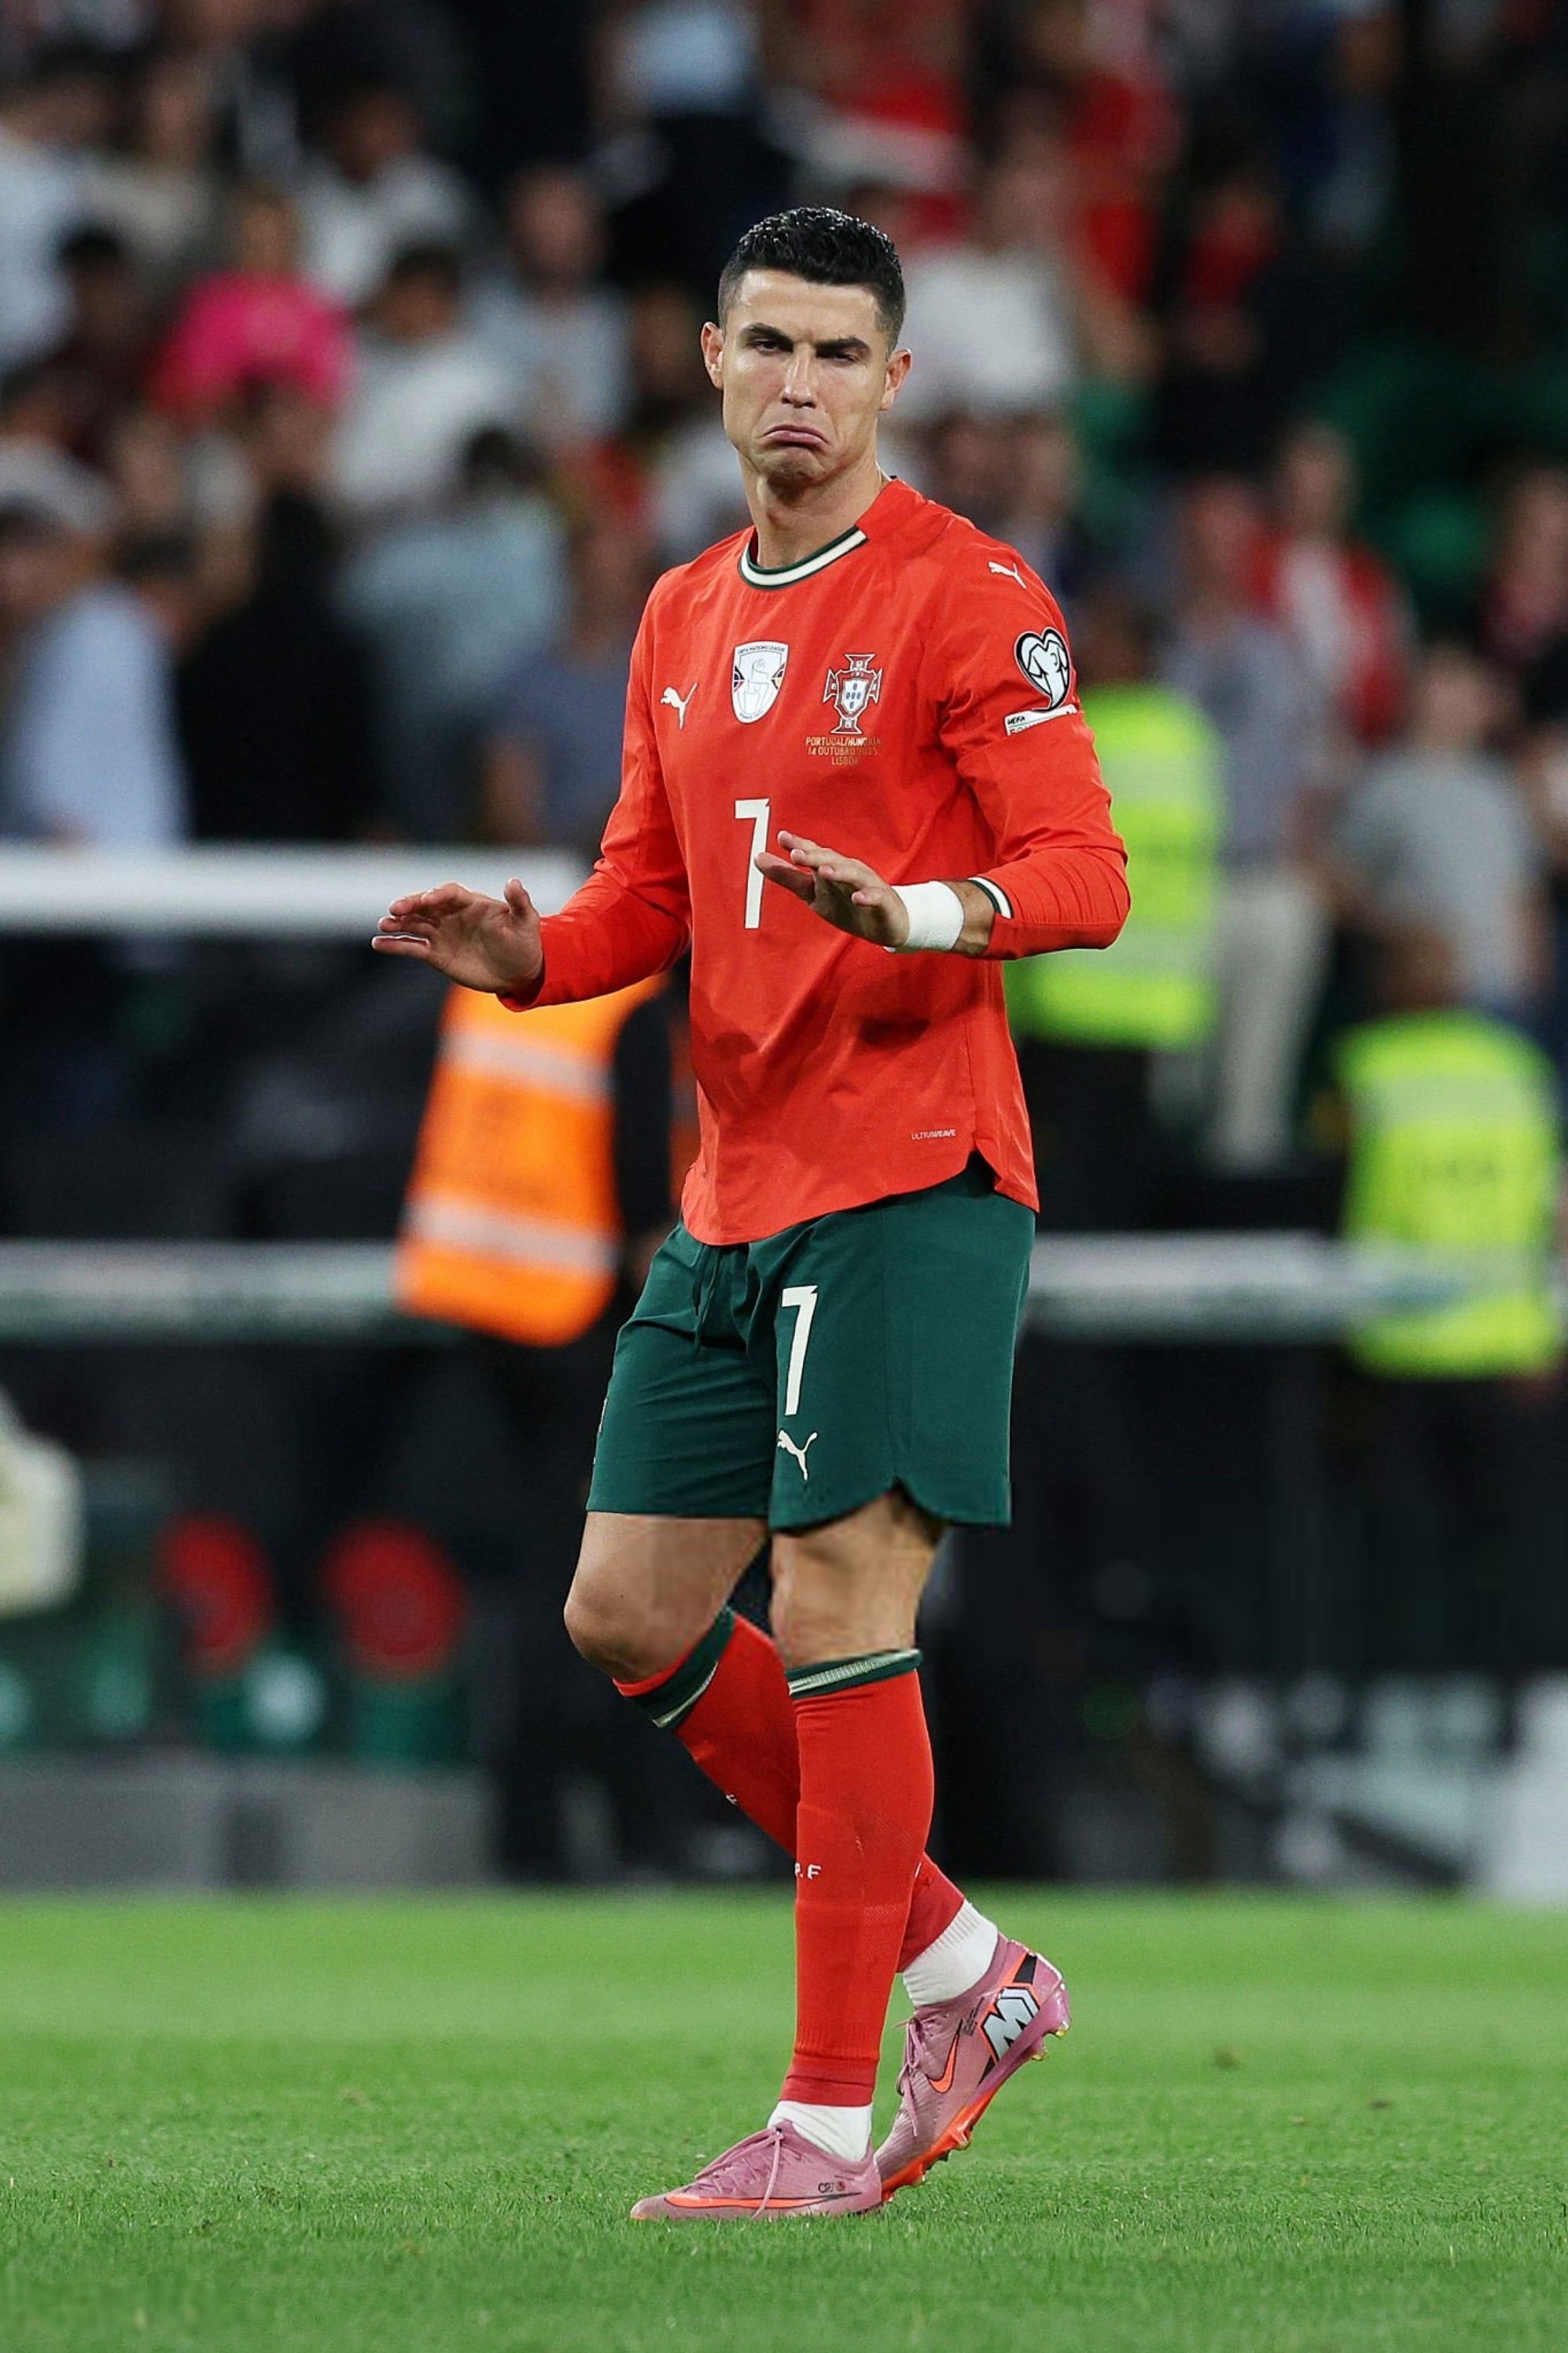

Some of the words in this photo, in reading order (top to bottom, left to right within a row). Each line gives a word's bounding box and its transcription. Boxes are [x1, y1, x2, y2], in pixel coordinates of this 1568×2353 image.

[1007, 716, 1025, 724] UEFA
[808, 746, 817, 756] 14
[819, 746, 856, 756] OUTUBRO
[830, 756, 861, 765] LISBOA
[734, 797, 771, 930] 7
[781, 1284, 819, 1416] 7
